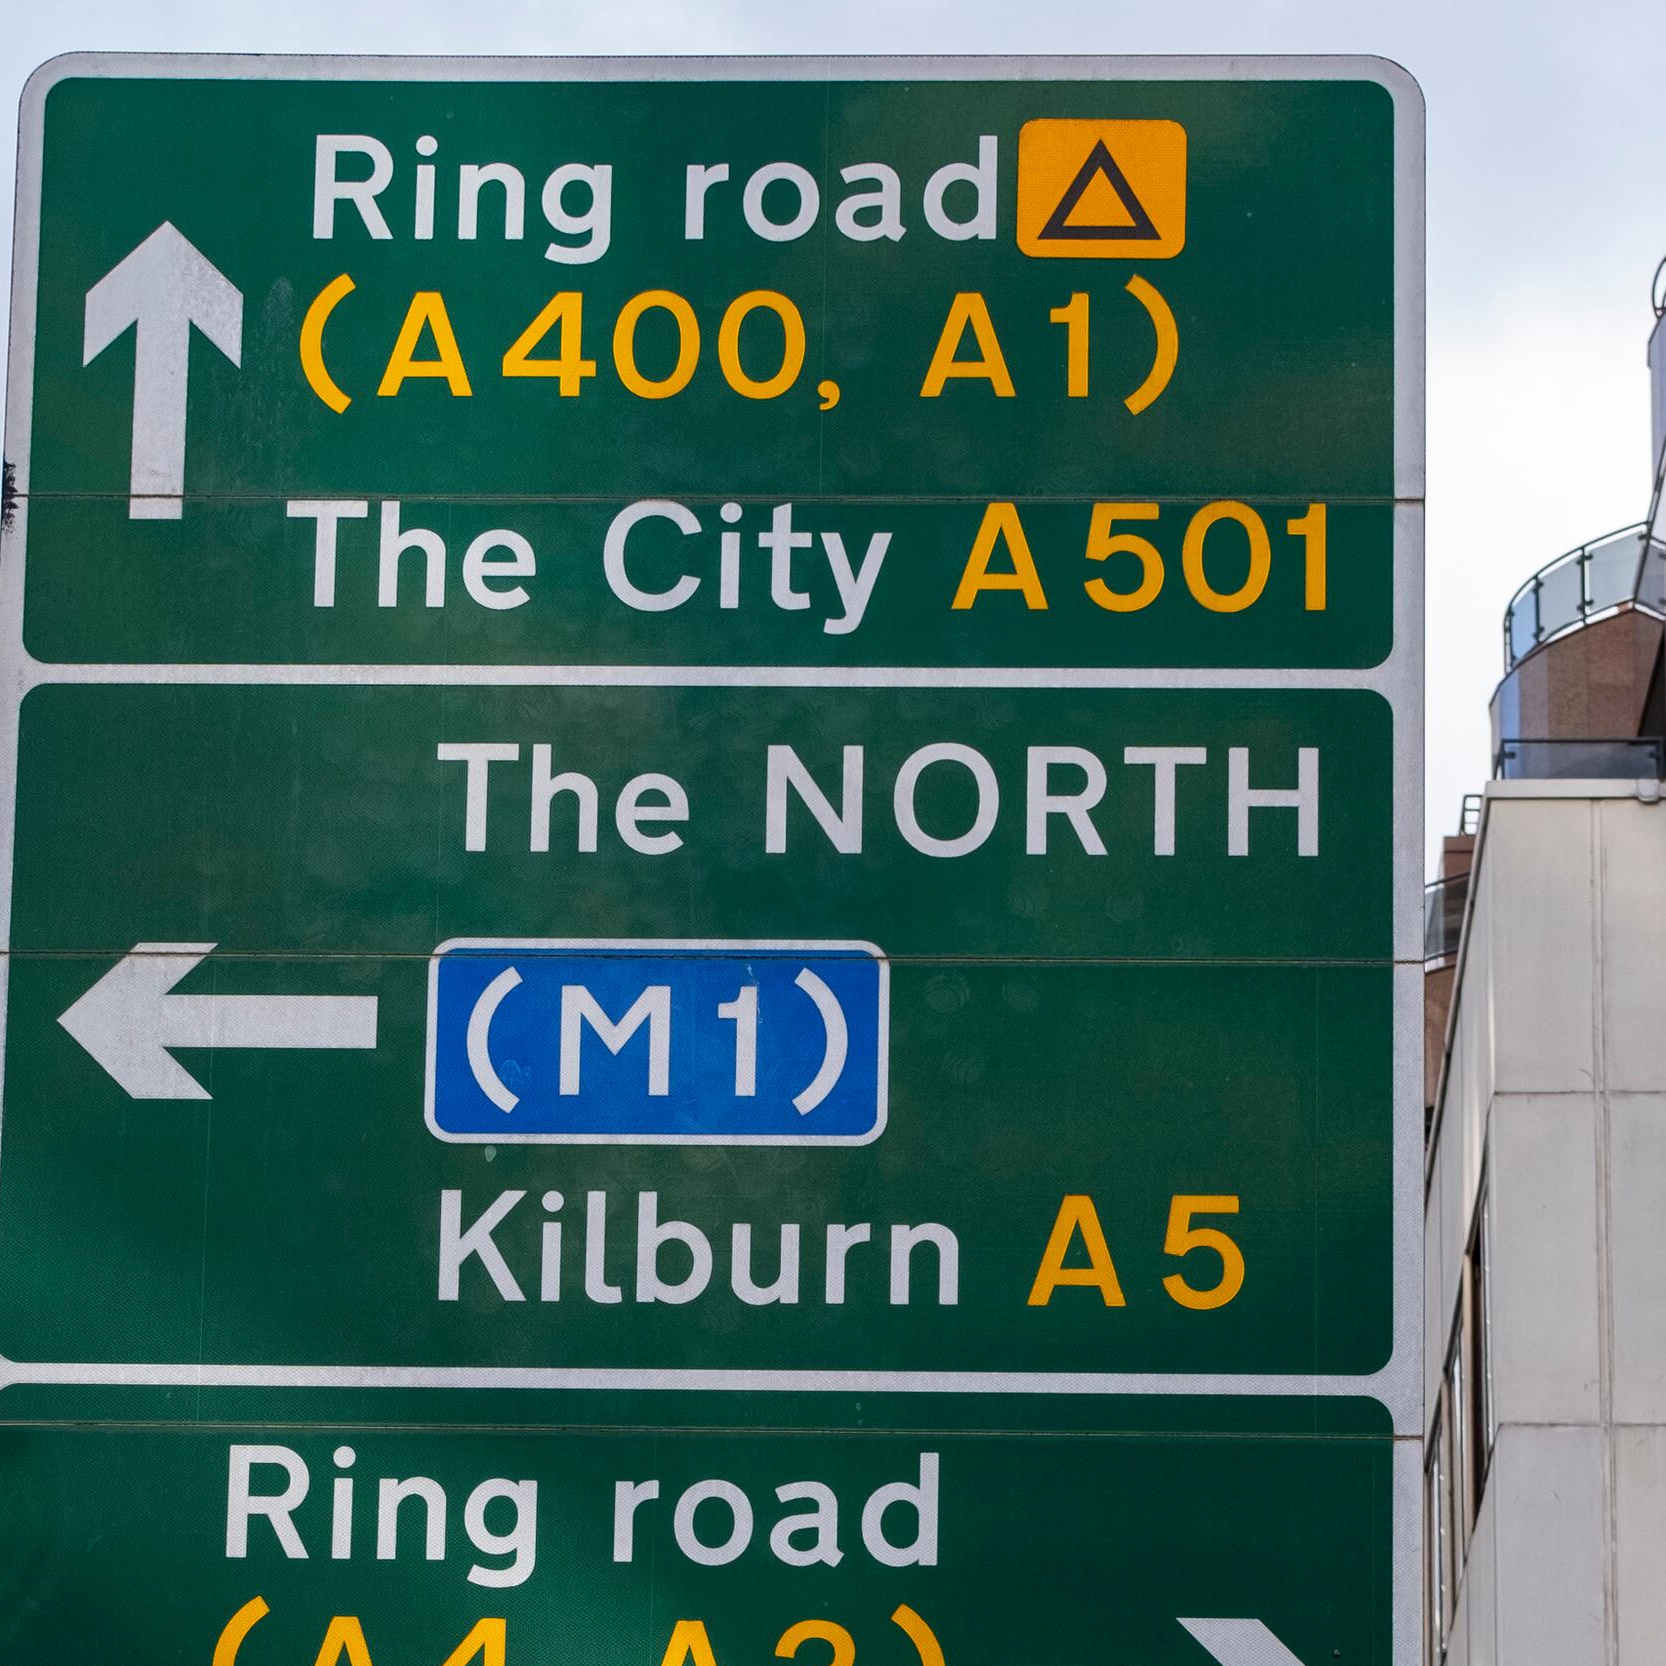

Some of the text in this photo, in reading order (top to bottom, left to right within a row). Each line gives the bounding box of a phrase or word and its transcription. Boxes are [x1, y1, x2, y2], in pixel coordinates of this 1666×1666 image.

[312, 134, 999, 264] Ring road
[286, 500, 535, 609] The
[602, 502, 892, 634] City
[436, 742, 1319, 859] The NORTH
[436, 1190, 958, 1306] Kilburn
[225, 1443, 940, 1589] Ring road
